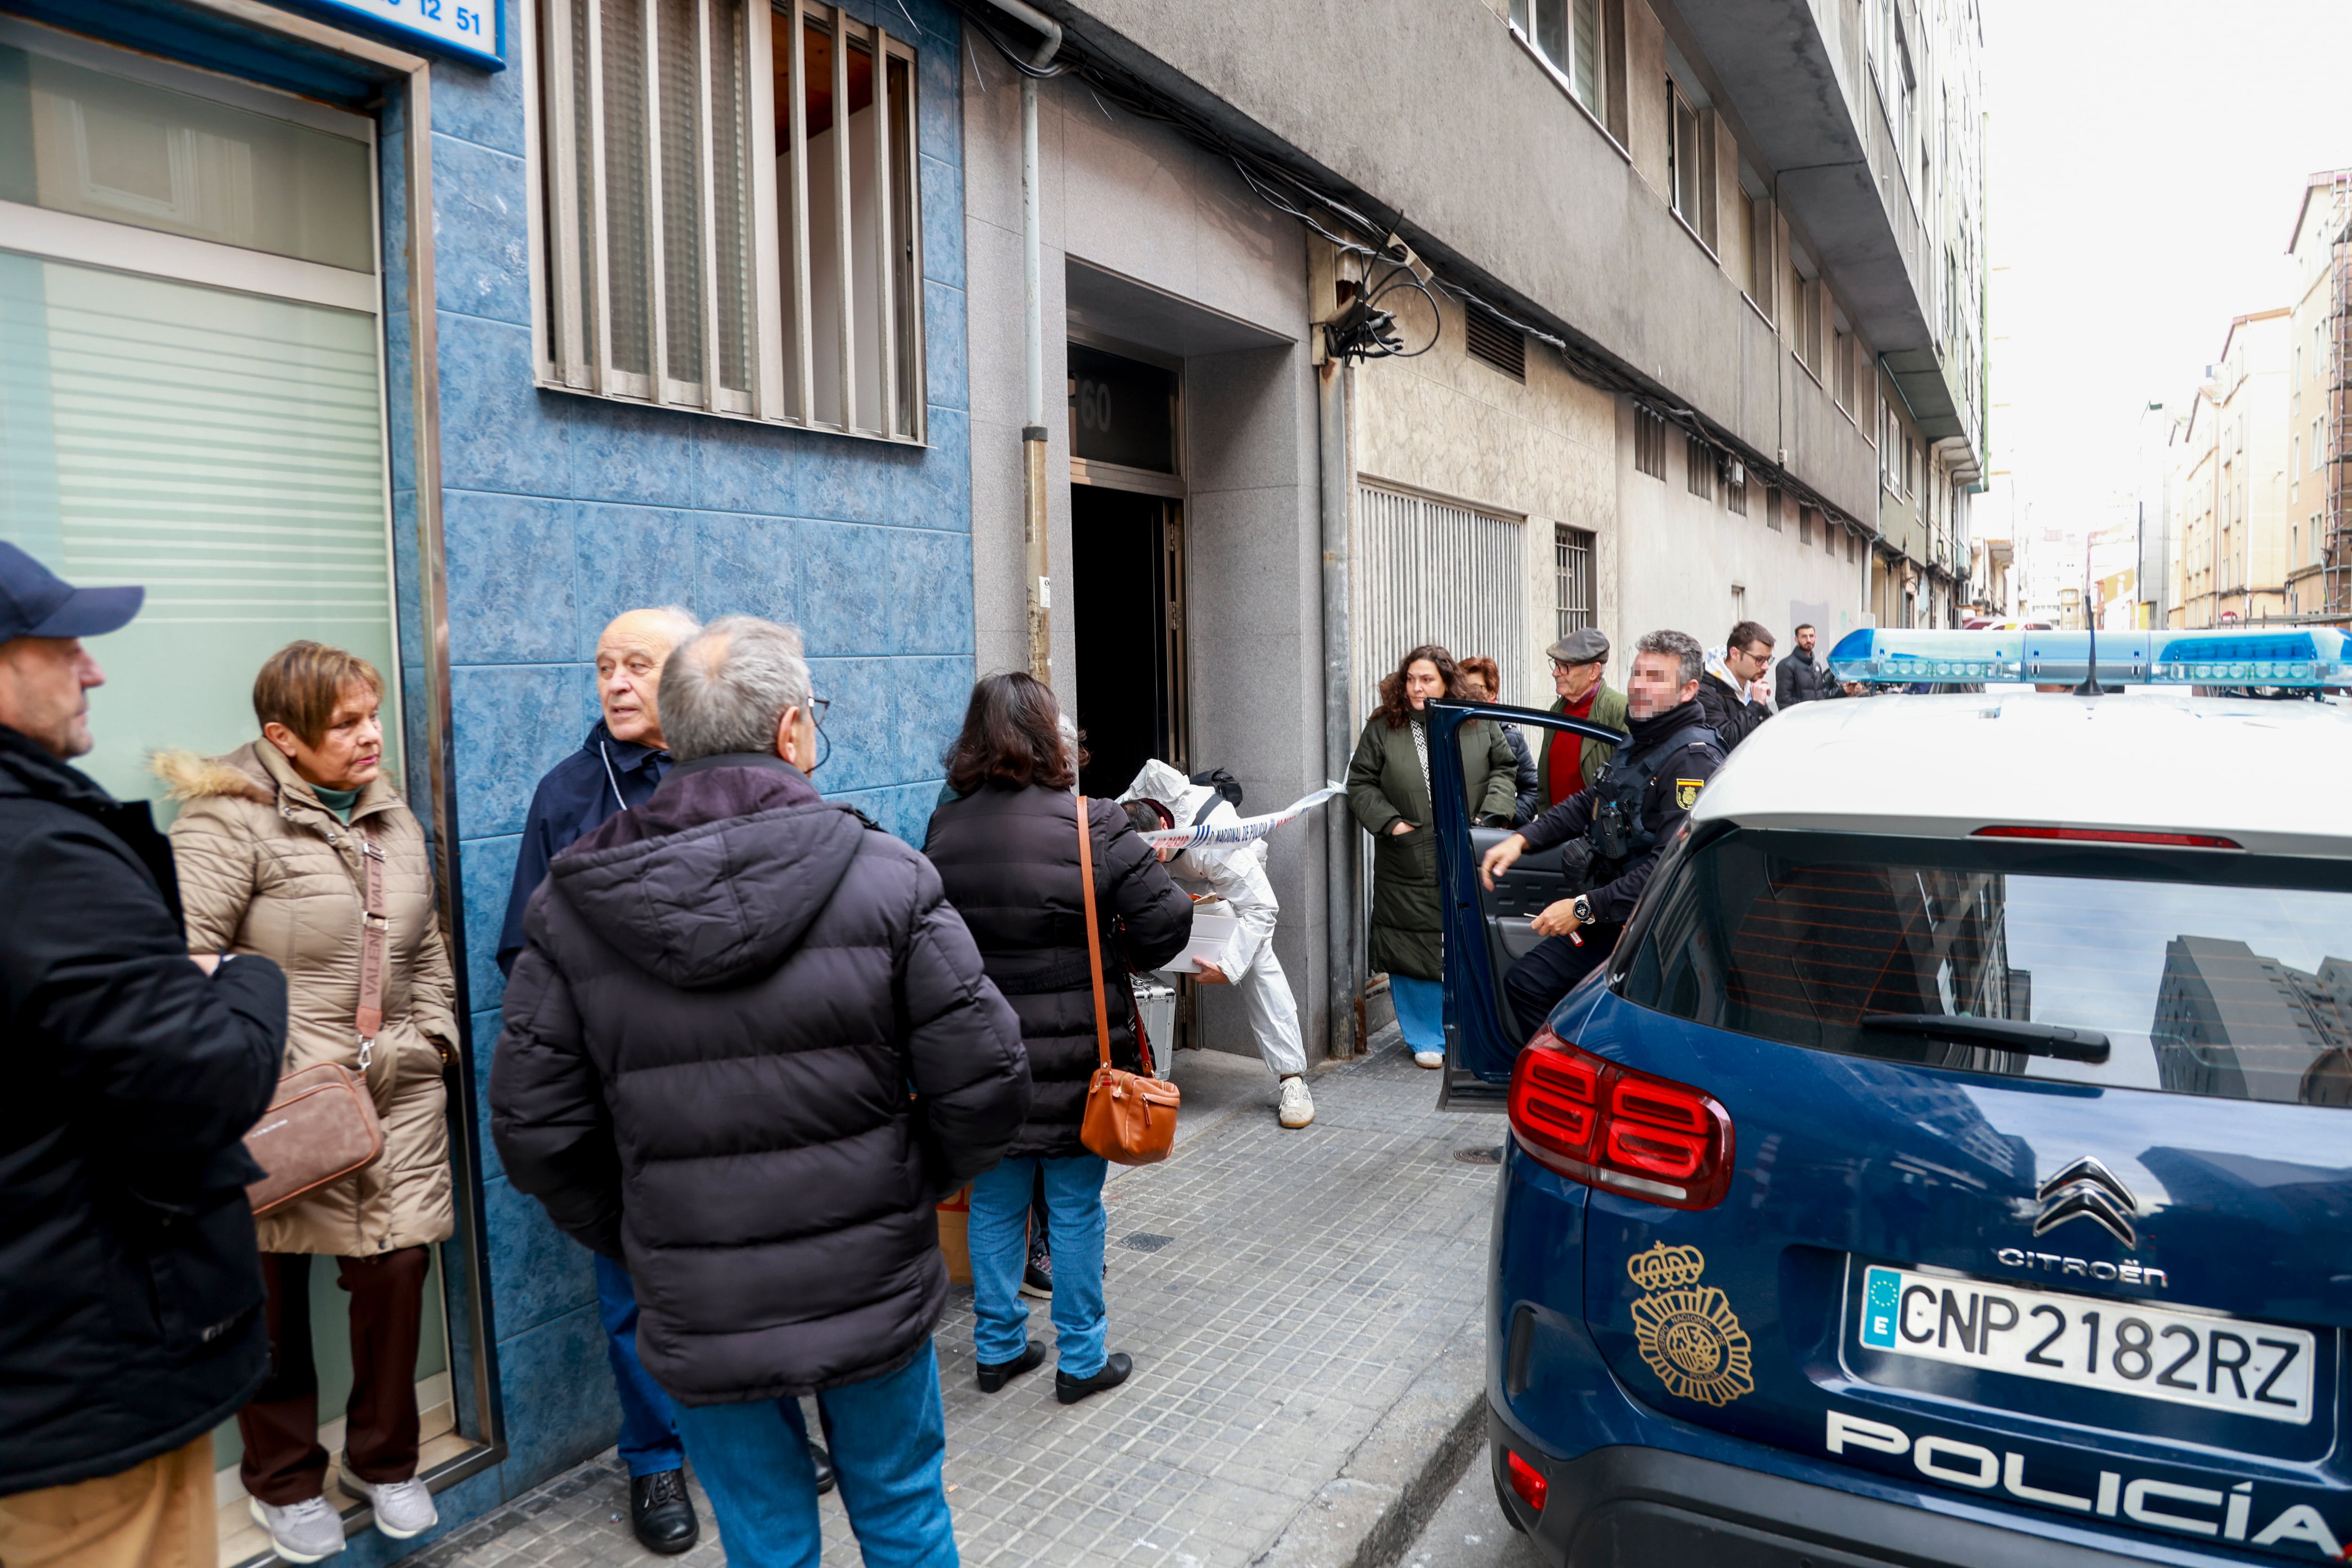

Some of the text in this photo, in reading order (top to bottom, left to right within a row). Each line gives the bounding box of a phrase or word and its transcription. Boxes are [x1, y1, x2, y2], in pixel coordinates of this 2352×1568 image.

[421, 0, 480, 35] 12 51
[1081, 380, 1111, 433] 60
[1215, 827, 1241, 845] NACIONAL
[1241, 825, 1249, 841] DE
[1249, 821, 1267, 841] POLICIA
[1659, 1324, 1669, 1359] CUERPO
[1670, 1313, 1712, 1330] NACIONAL
[1716, 1333, 1727, 1347] DE
[1874, 1285, 2300, 1408] E CNP2182RZ
[1826, 1409, 2345, 1559] POLICÍA
